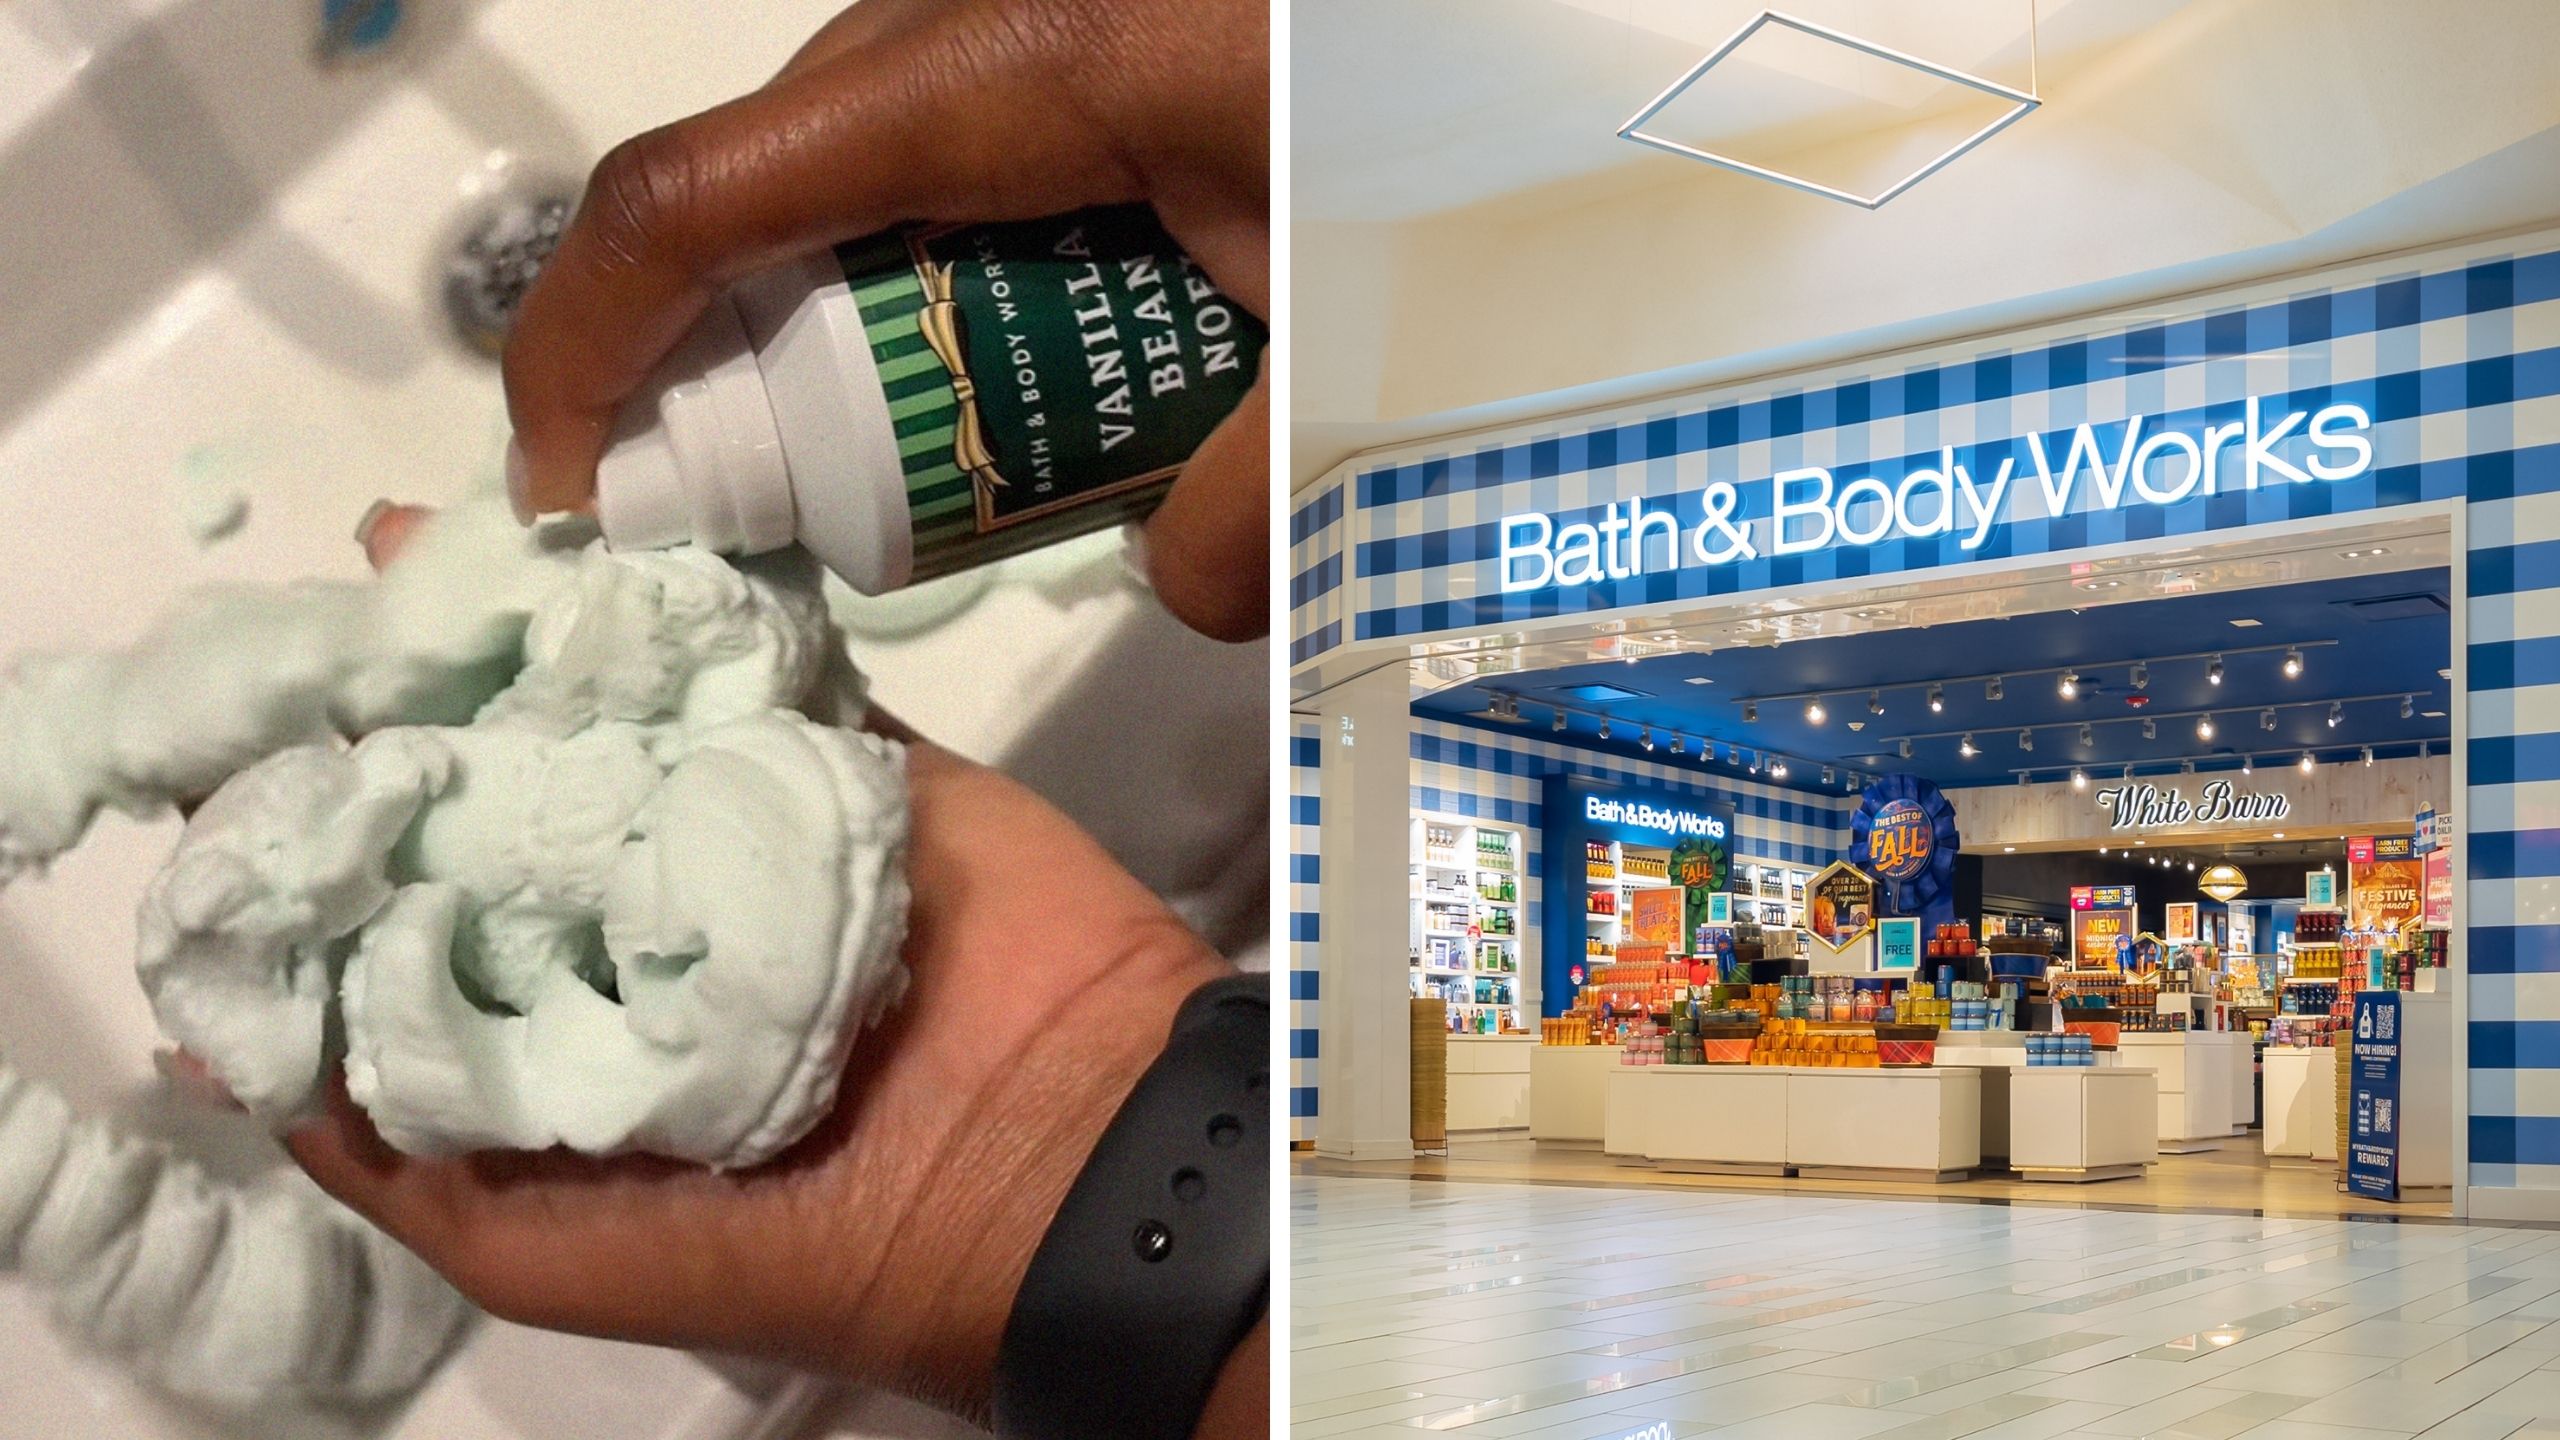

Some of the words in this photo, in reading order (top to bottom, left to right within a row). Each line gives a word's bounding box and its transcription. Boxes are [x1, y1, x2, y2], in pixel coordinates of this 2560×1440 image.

[973, 234, 1019, 322] WORKS
[1120, 255, 1186, 397] BEAN
[1053, 227, 1135, 452] VANILLA
[1005, 333, 1040, 402] BODY
[1026, 412, 1046, 427] &
[1030, 438, 1052, 492] BATH
[1500, 496, 1679, 593] Bath
[1693, 481, 1759, 565] &
[1772, 444, 2015, 551] Body
[2027, 396, 2373, 517] Works
[2096, 783, 2191, 828] White
[2195, 779, 2288, 821] Barn
[1586, 796, 1626, 823] Bath
[1625, 802, 1639, 826] &
[1638, 804, 1679, 835] Body
[1678, 811, 1725, 838] Works
[1875, 816, 1890, 827] THE
[1890, 812, 1911, 824] BEST
[1911, 811, 1923, 820] OF
[1870, 825, 1928, 871] FALL
[2376, 845, 2409, 853] PRODUCTS
[1682, 862, 1713, 885] FALL
[1831, 877, 1850, 885] OVER
[2359, 889, 2417, 902] FESTIVE
[2087, 919, 2121, 932] NEW
[1885, 944, 1913, 956] FREE
[2355, 1043, 2371, 1055] NOW
[2371, 1045, 2397, 1056] HIRING!
[2357, 1152, 2389, 1167] REWARDS
